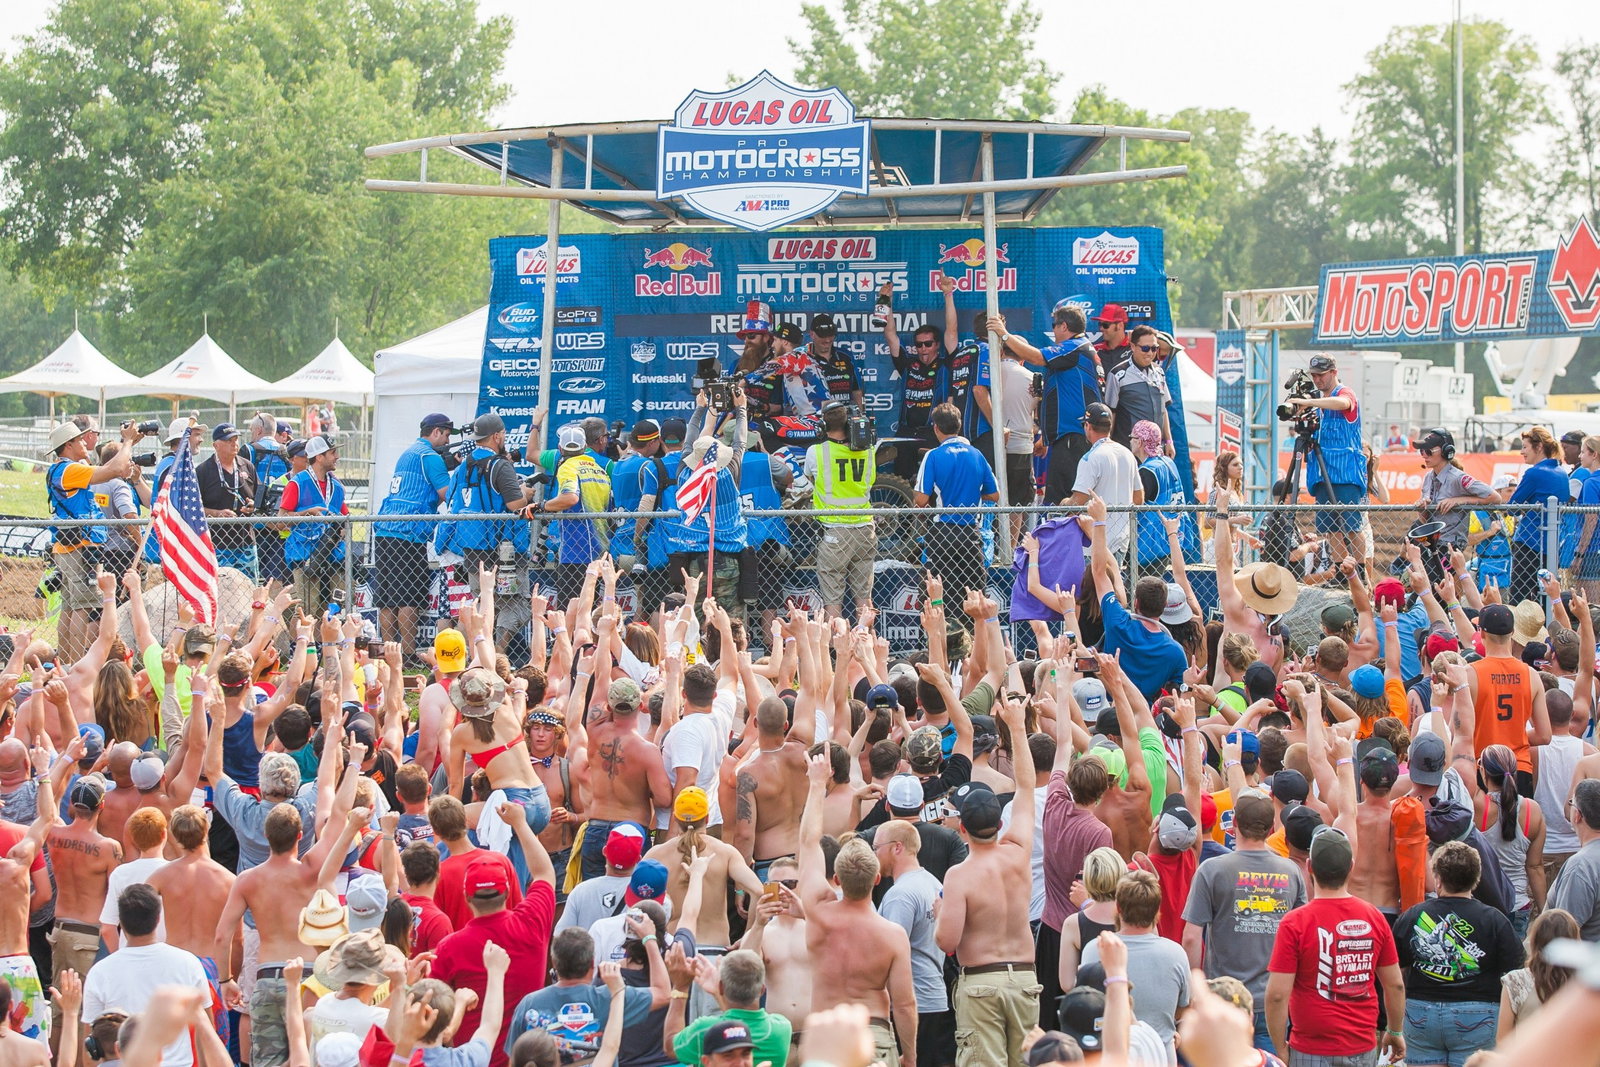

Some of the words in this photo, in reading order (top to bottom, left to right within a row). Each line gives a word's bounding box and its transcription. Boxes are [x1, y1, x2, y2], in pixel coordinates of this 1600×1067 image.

[692, 100, 784, 126] LUCAS
[789, 99, 832, 124] OIL
[738, 139, 788, 148] PRO
[666, 148, 860, 172] MOTOCROSS
[665, 168, 860, 181] CHAMPIONSHIP
[734, 200, 769, 211] AMA
[772, 239, 838, 260] LUCAS
[841, 238, 872, 259] OIL
[1079, 250, 1136, 264] LUCAS
[523, 258, 578, 274] LUAS
[799, 263, 846, 271] PRO
[1092, 267, 1137, 275] PRODUCTS
[520, 277, 534, 285] OIL
[536, 276, 579, 285] PRUCTS
[635, 272, 677, 297] Red
[680, 271, 721, 296] Bull
[737, 271, 908, 294] MOTOCROSS
[736, 294, 909, 303] CHAMPIONSP
[510, 308, 536, 316] BUD
[557, 310, 597, 318] GoPro
[1121, 304, 1152, 312] oPro
[505, 315, 539, 323] LIGHT
[814, 312, 927, 332] ATINA
[499, 337, 543, 350] FLY
[556, 332, 605, 350] WPS
[666, 342, 719, 361] WPS
[489, 359, 540, 371] GEICO
[632, 373, 687, 384] Kawasaki
[560, 379, 604, 391] FMF
[556, 399, 606, 415] FRAM
[646, 401, 695, 410] SUZUKI
[504, 433, 530, 444] ERTE
[836, 459, 866, 482] TV
[1491, 673, 1521, 685] PURVIS
[1496, 693, 1513, 721] 5
[49, 837, 101, 857] ANDREWS
[1453, 918, 1475, 938] 22
[1335, 953, 1374, 965] BREYLEY
[1343, 962, 1372, 973] YAMAHA
